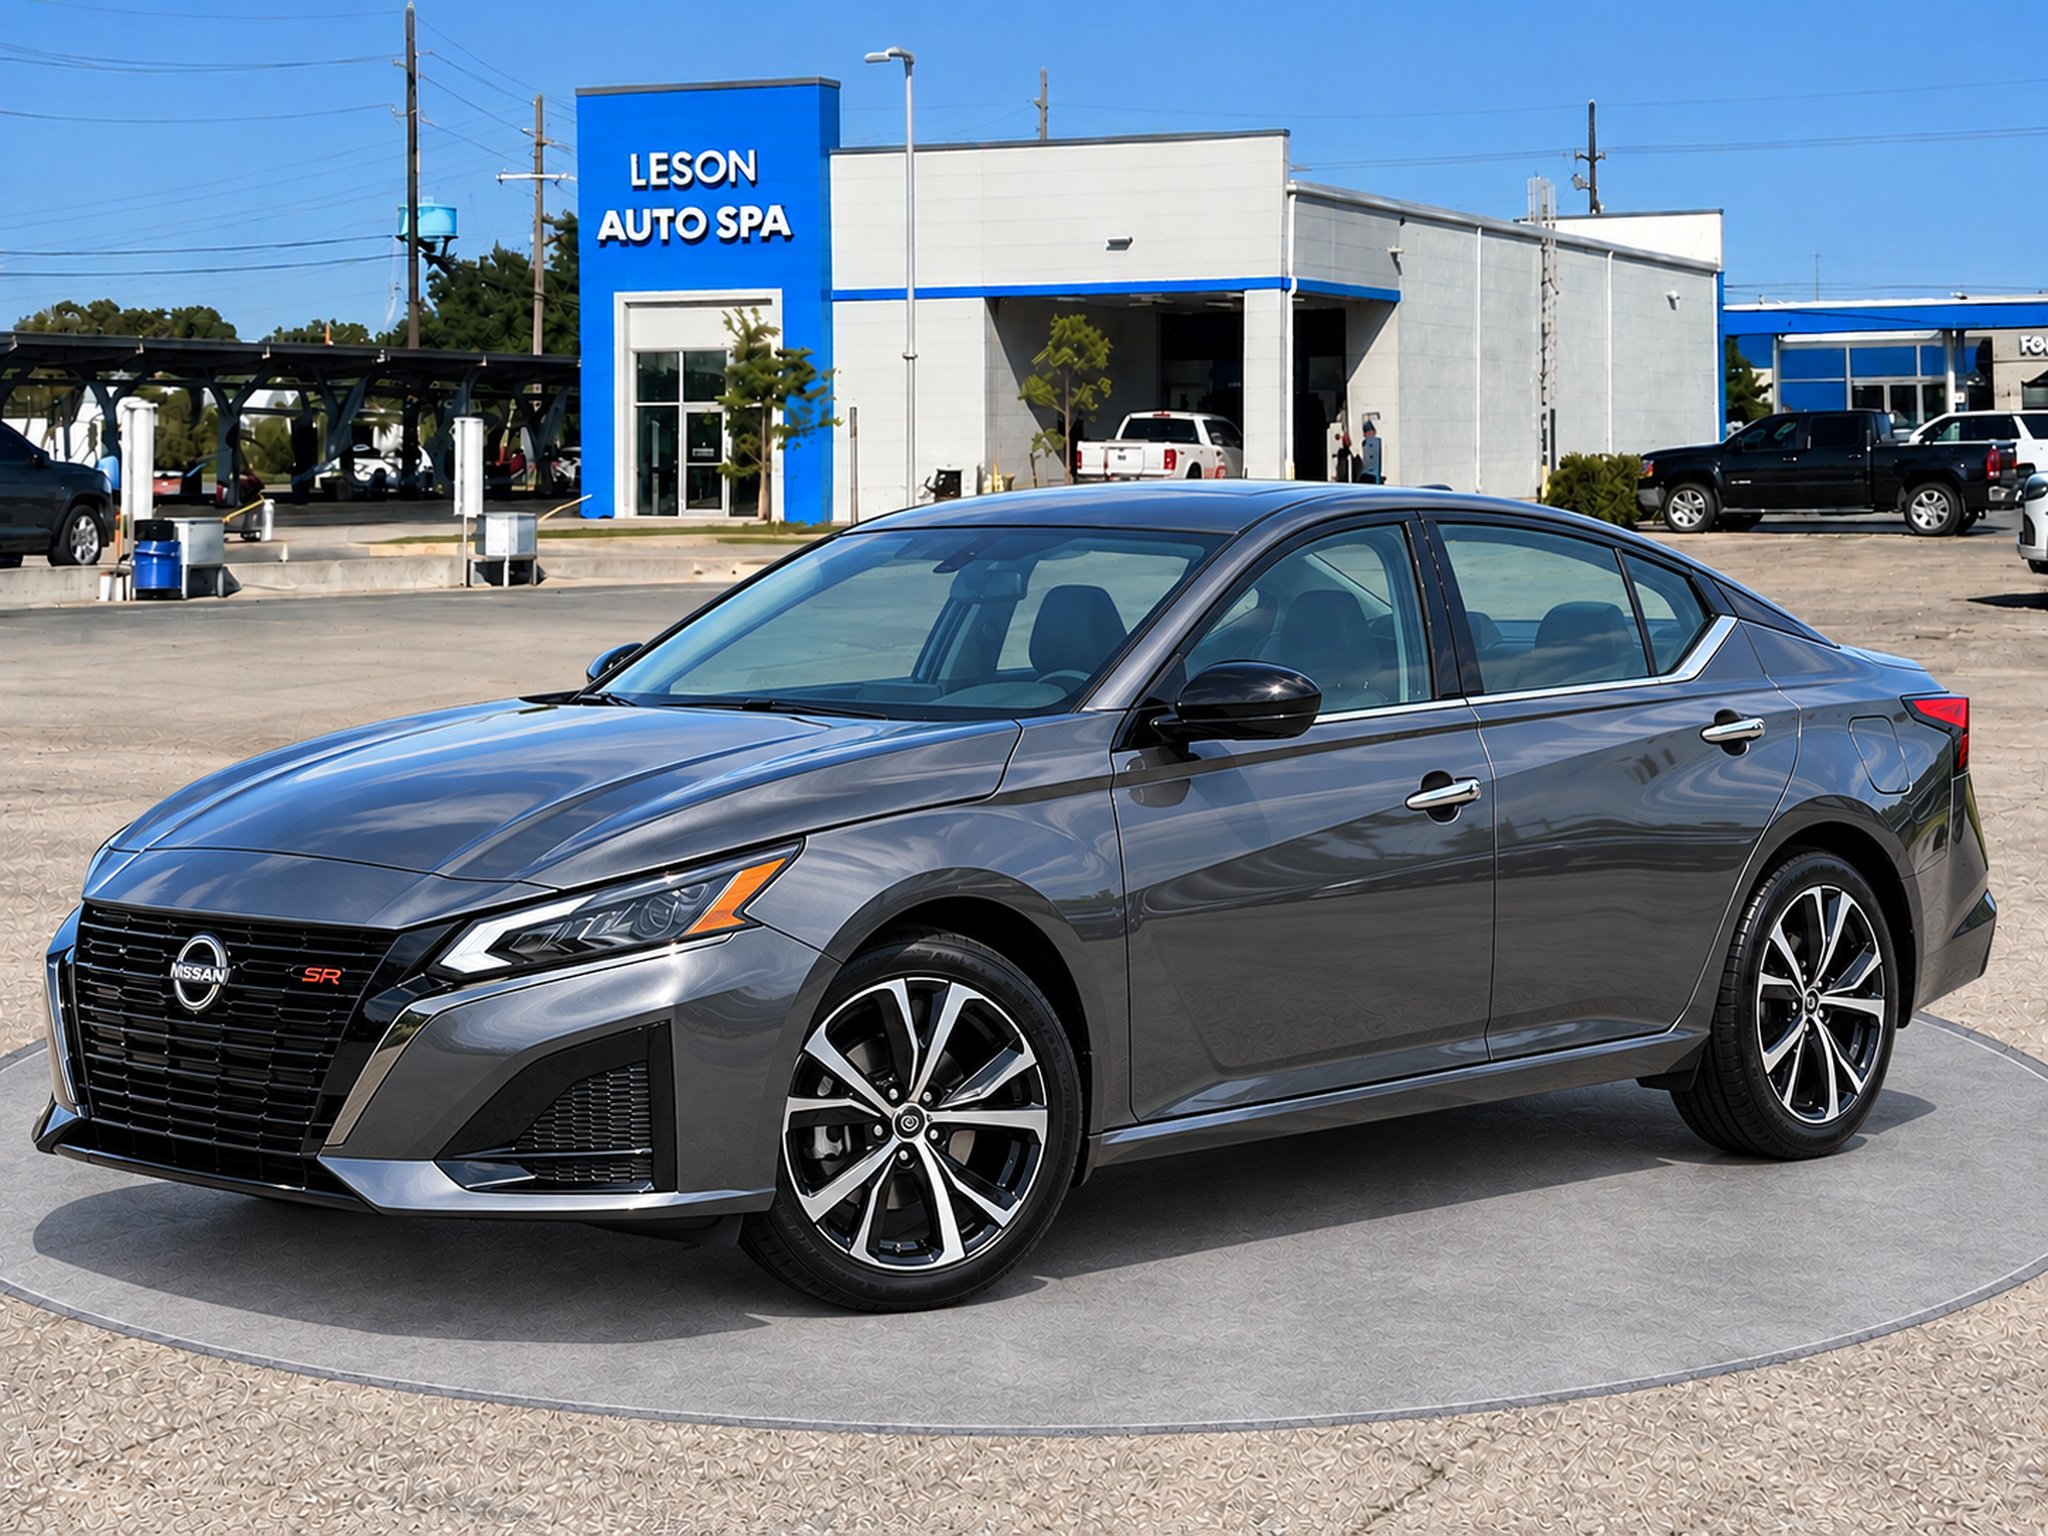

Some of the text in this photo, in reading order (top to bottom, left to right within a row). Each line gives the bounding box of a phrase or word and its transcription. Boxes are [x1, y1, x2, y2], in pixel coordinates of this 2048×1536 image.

[630, 149, 757, 188] LESON
[597, 204, 793, 243] AUTO SPA
[2019, 335, 2048, 355] FO
[170, 961, 227, 985] NISSAN
[301, 966, 343, 985] SR
